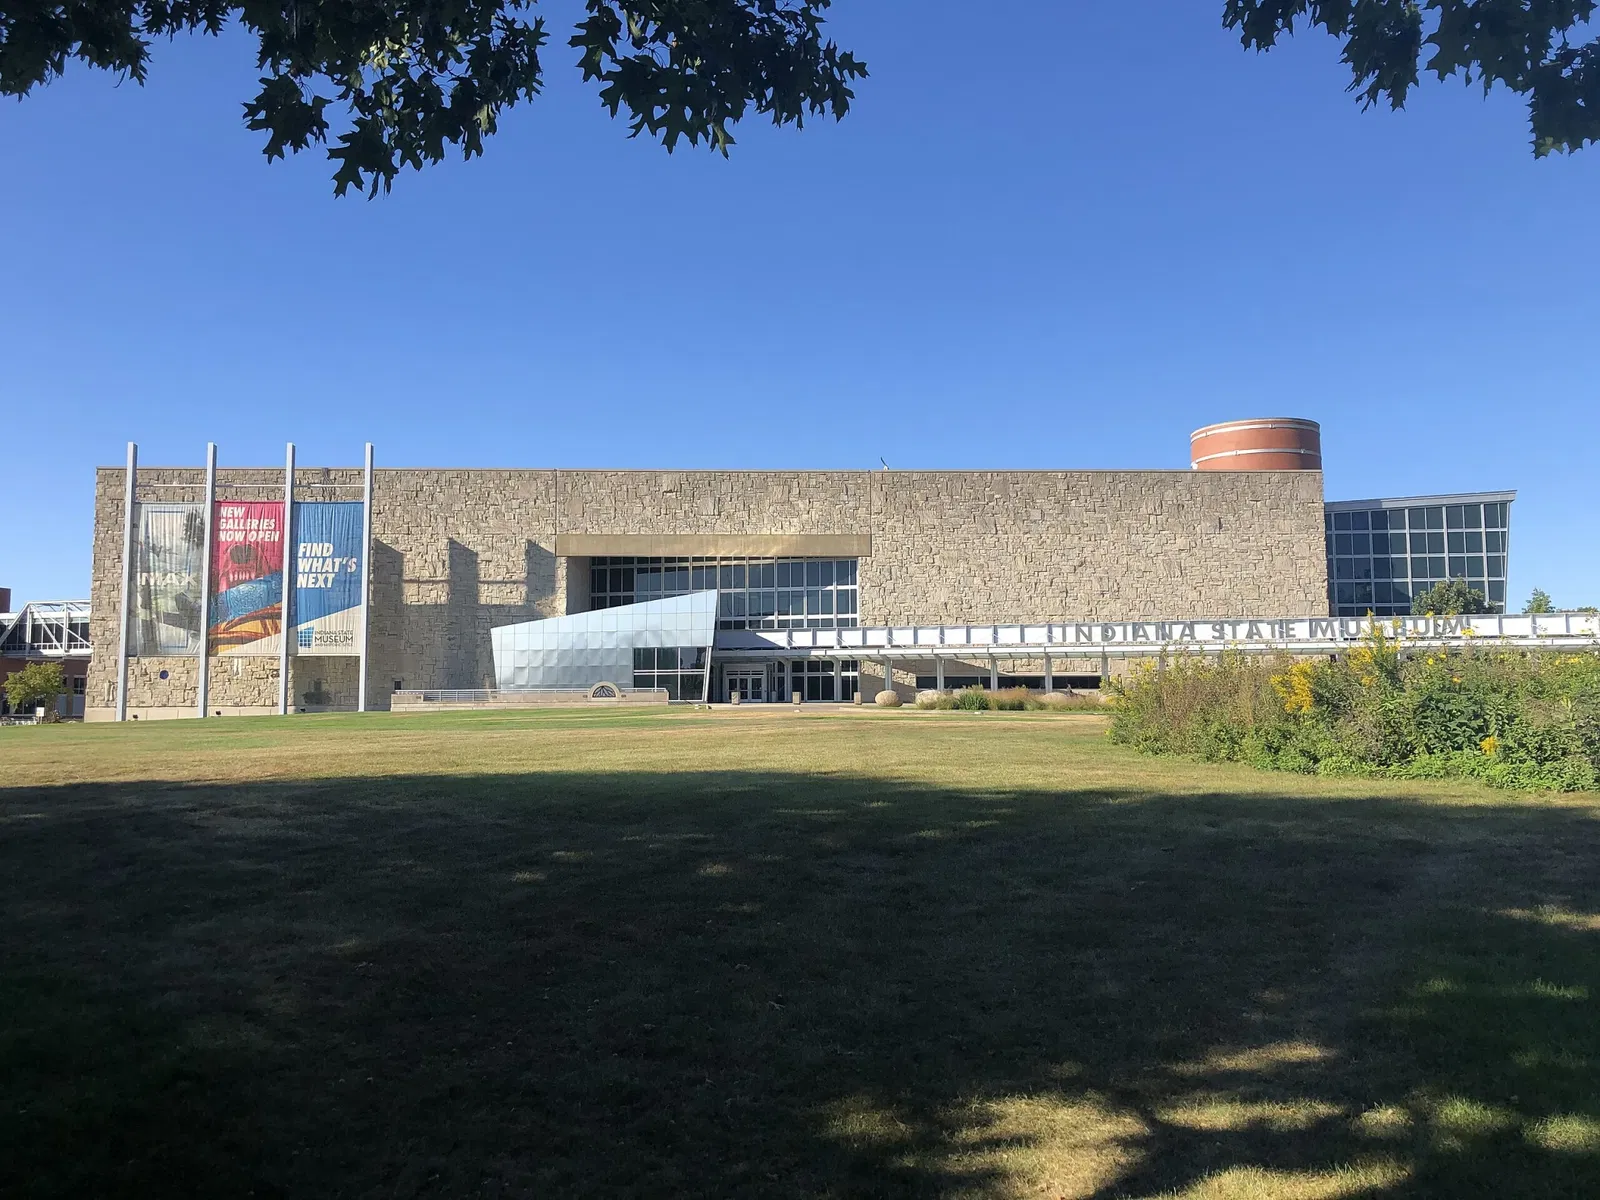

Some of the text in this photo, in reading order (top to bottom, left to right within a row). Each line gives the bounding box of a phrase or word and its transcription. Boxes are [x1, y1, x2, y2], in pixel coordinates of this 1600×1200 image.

[220, 506, 245, 518] NEW
[220, 518, 275, 530] GALLERIES
[219, 530, 280, 542] NOW OPEN
[298, 542, 334, 557] FIND
[298, 557, 357, 573] WHAT'S
[136, 572, 198, 587] IMAX
[297, 573, 335, 588] NEXT
[1061, 617, 1468, 642] INDIANA STATE MUUM
[315, 635, 353, 643] MUSEUM
